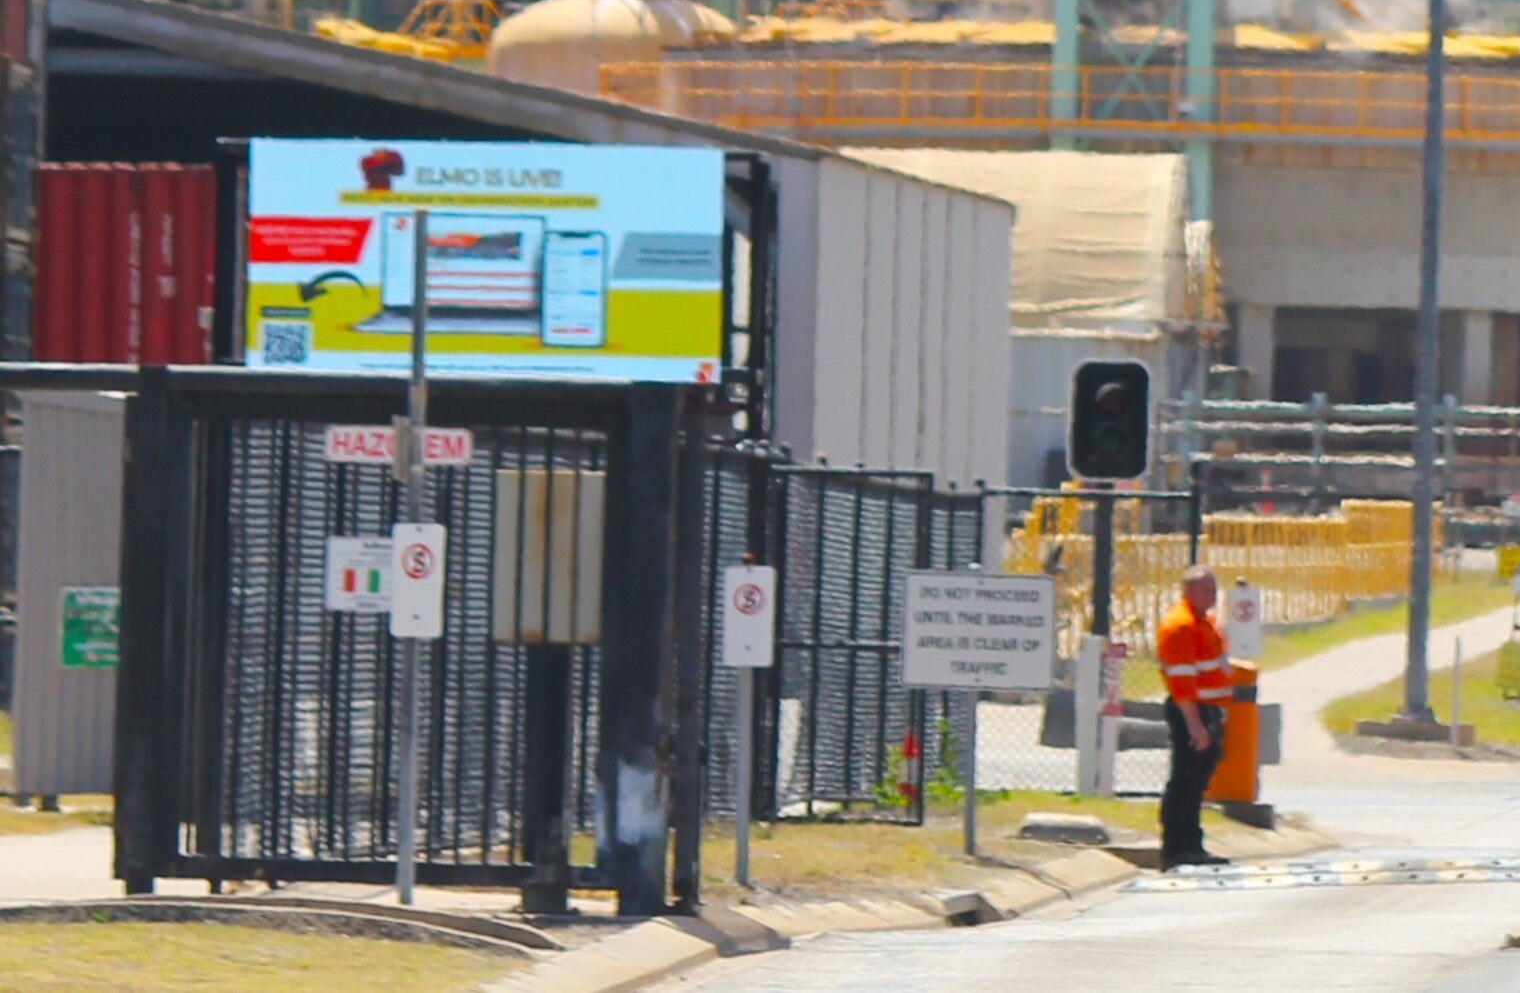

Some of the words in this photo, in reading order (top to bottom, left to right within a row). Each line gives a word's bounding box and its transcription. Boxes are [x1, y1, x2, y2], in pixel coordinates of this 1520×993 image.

[416, 166, 479, 186] ELMO
[484, 168, 503, 186] IS
[919, 586, 940, 600] DO
[944, 587, 972, 600] NOT
[975, 588, 1040, 603] PROCEED
[913, 610, 953, 625] UNTIL
[958, 611, 983, 625] THE
[917, 635, 953, 649] AREA
[958, 636, 970, 649] IS
[974, 637, 1018, 651] CLEAR
[1022, 638, 1041, 652] OF
[950, 660, 1008, 675] TRAFFIC
